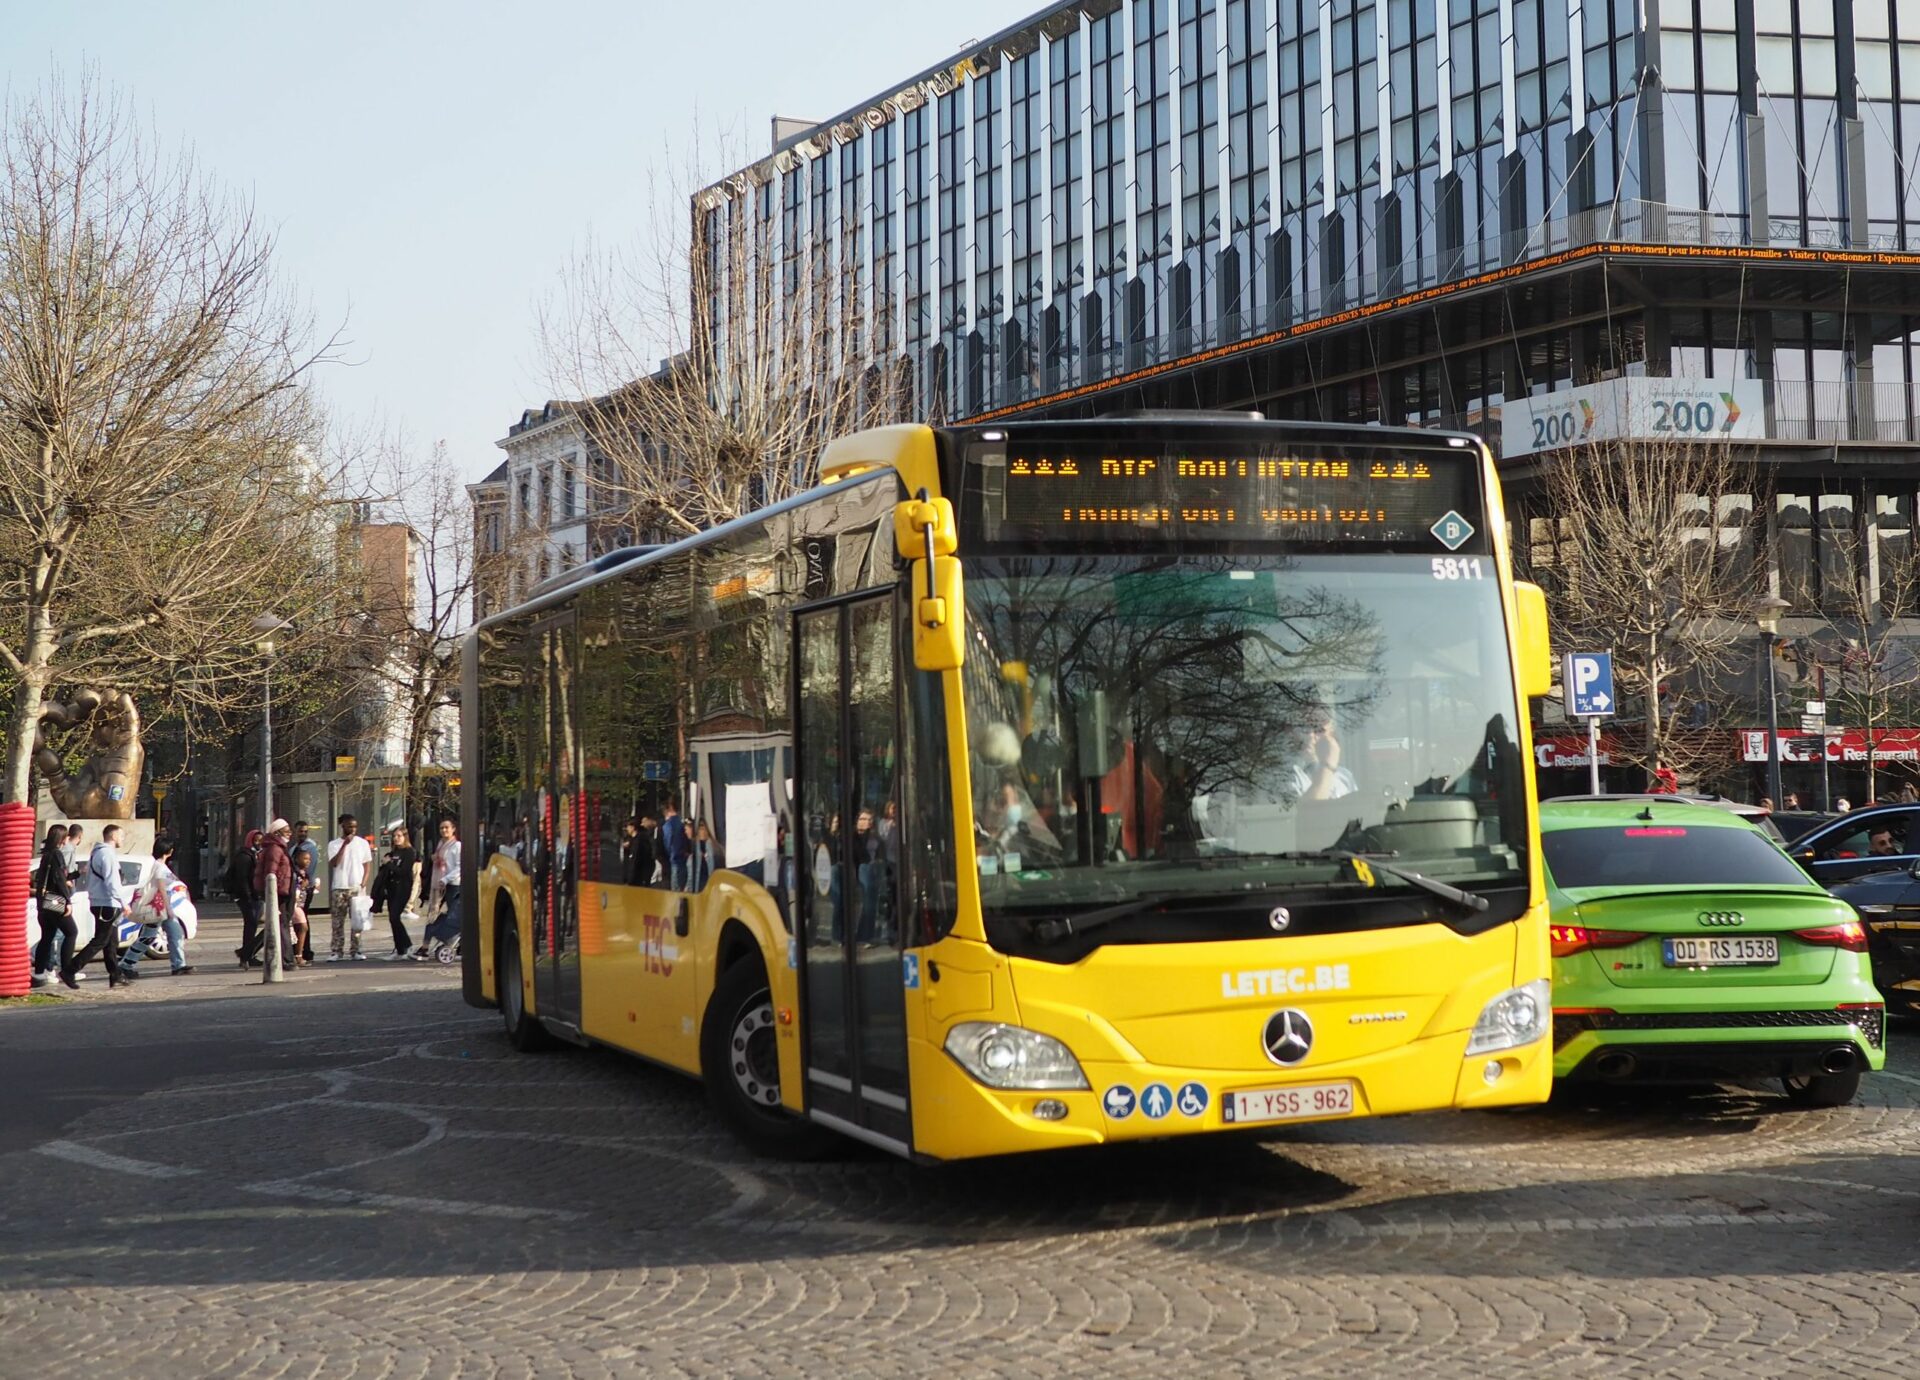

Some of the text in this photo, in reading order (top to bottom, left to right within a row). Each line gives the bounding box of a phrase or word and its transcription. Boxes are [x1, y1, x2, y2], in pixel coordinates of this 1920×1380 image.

[1525, 256, 1562, 270] Luxembourg
[1622, 245, 1666, 254] événement
[1668, 248, 1688, 256] pour
[1702, 248, 1727, 256] écoles
[1751, 250, 1782, 258] familles
[1789, 251, 1816, 259] Visitez
[1822, 252, 1872, 261] Questionnez
[1532, 412, 1576, 448] 200
[1653, 401, 1714, 432] 200
[1431, 558, 1483, 580] 5811
[1574, 658, 1600, 695] P
[643, 914, 673, 978] TEC
[1676, 940, 1775, 959] OD RS 1538
[1222, 964, 1350, 998] LETEC.BE
